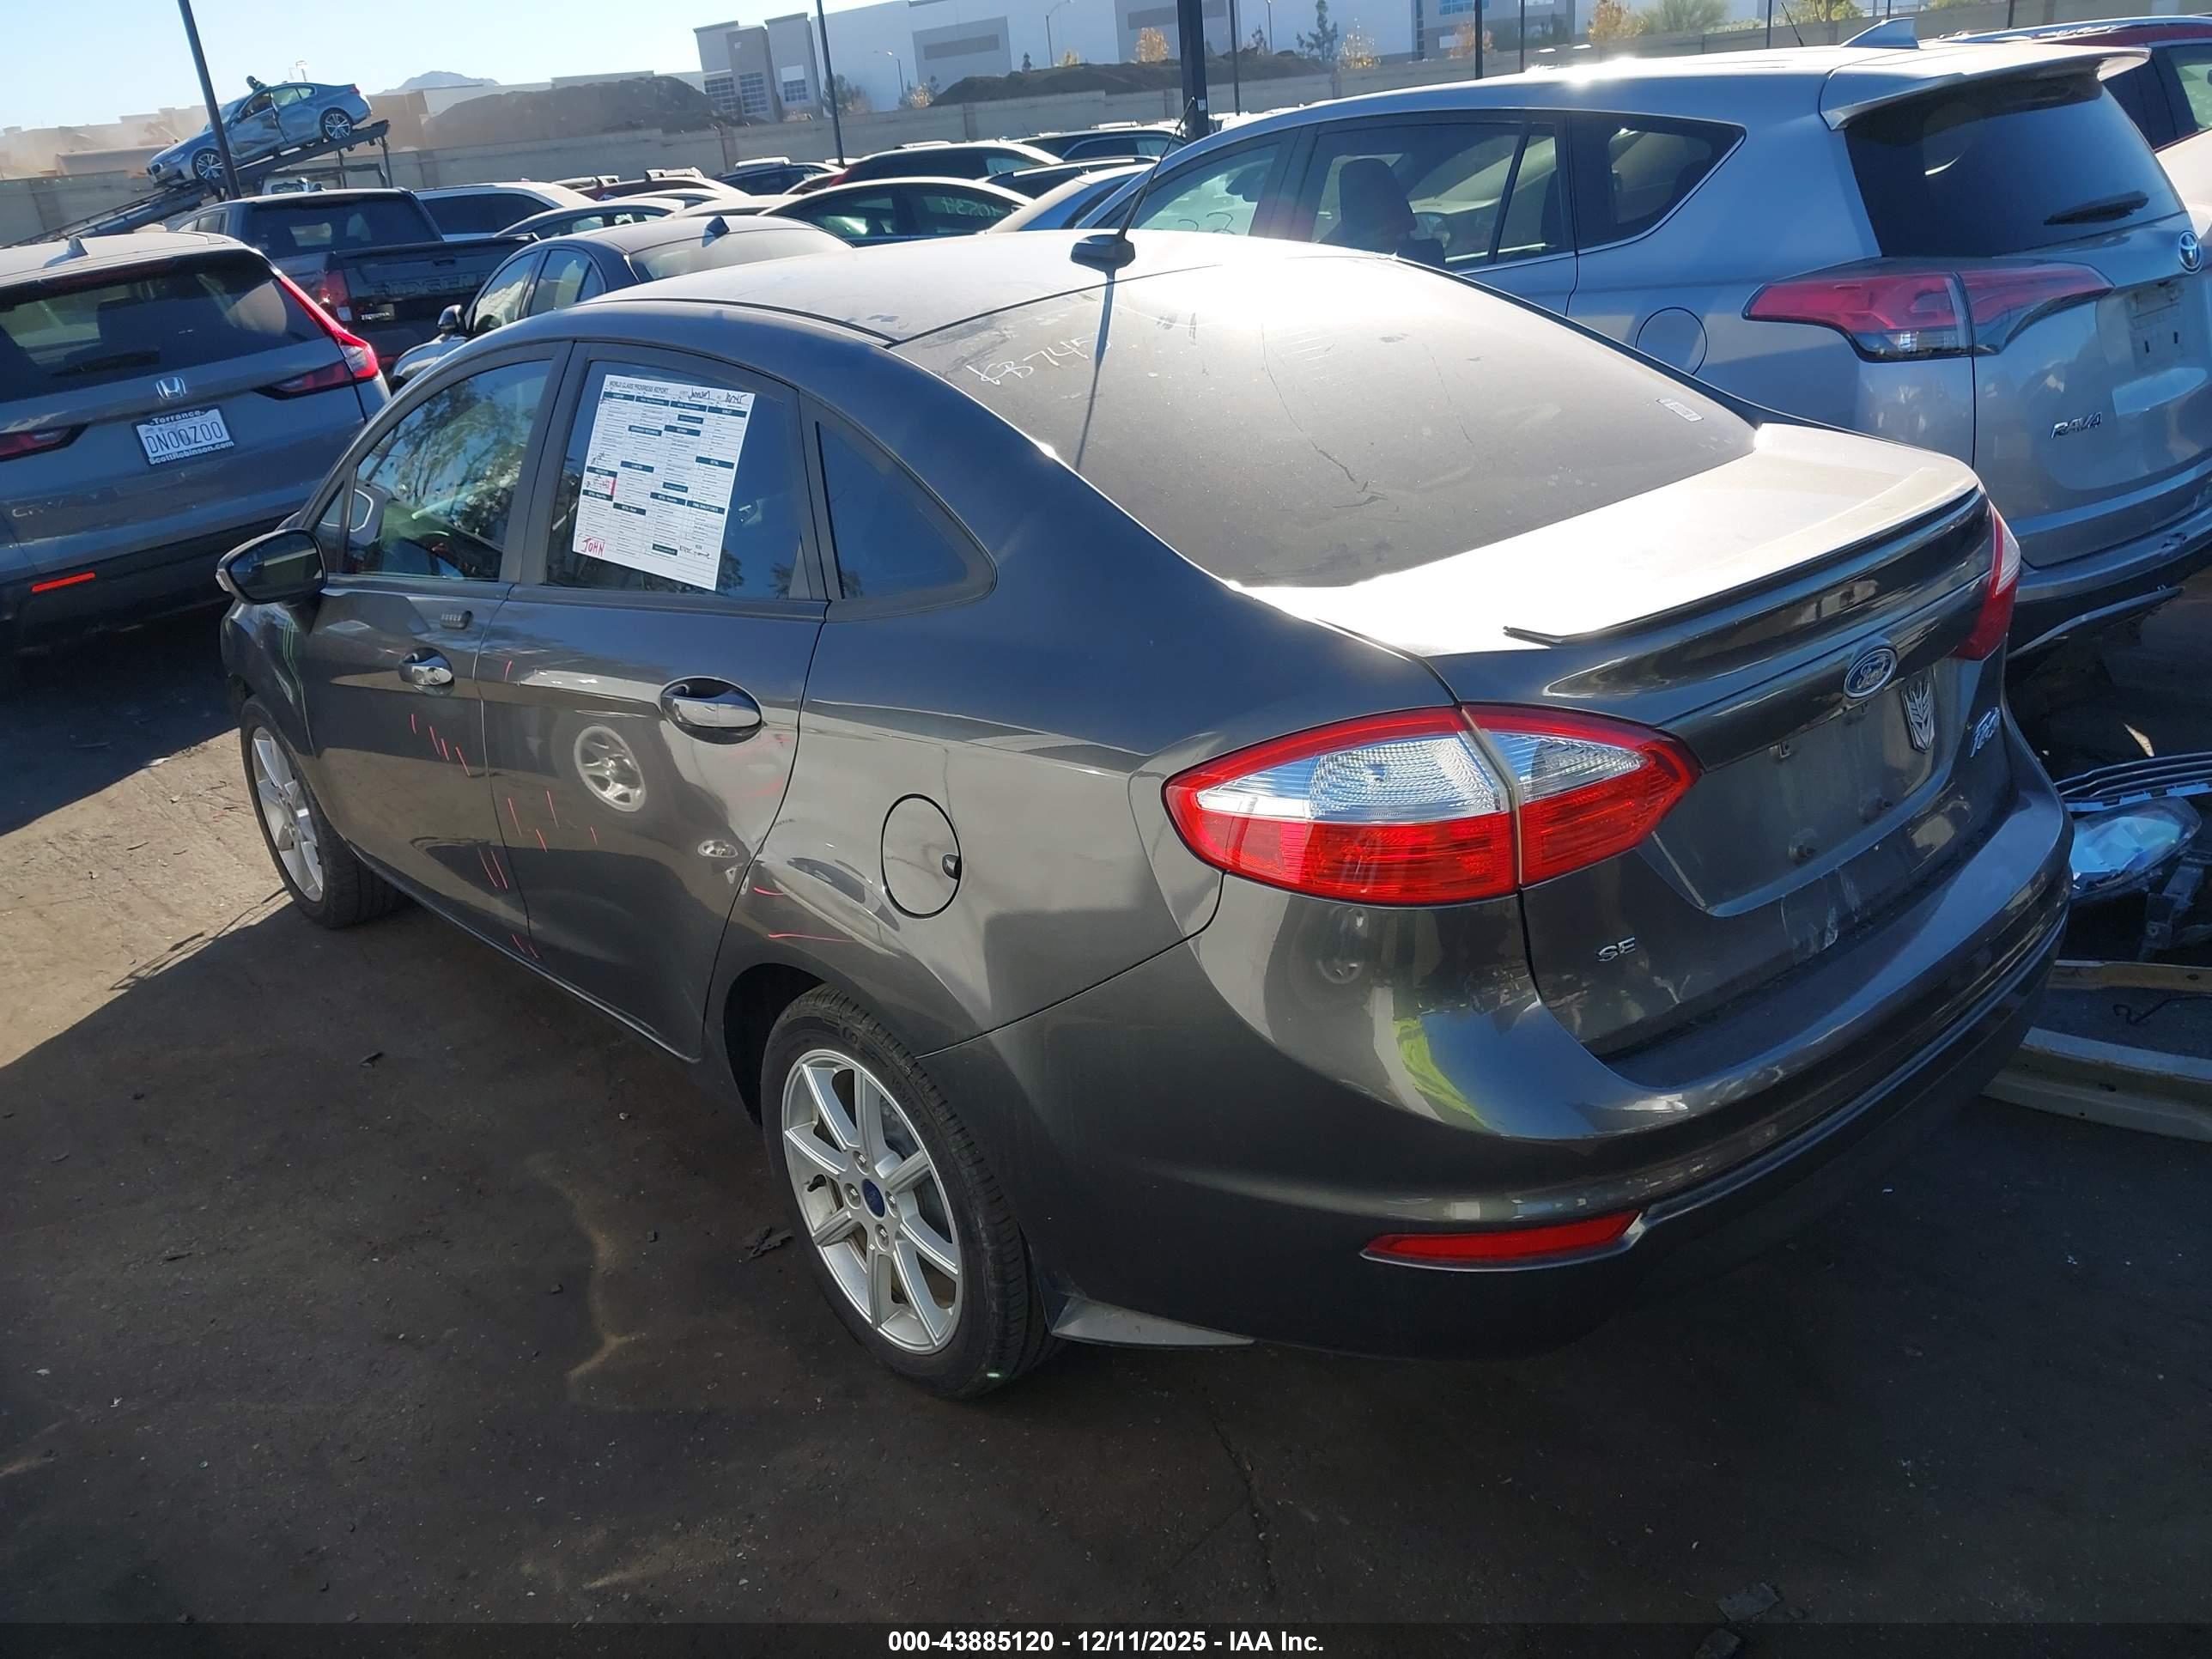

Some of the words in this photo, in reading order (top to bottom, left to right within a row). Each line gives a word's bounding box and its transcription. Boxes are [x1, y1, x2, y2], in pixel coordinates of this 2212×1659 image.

[653, 386, 670, 394] REPORT
[2051, 411, 2102, 439] RAV4
[580, 538, 605, 556] JOHN
[1597, 937, 1636, 962] SE
